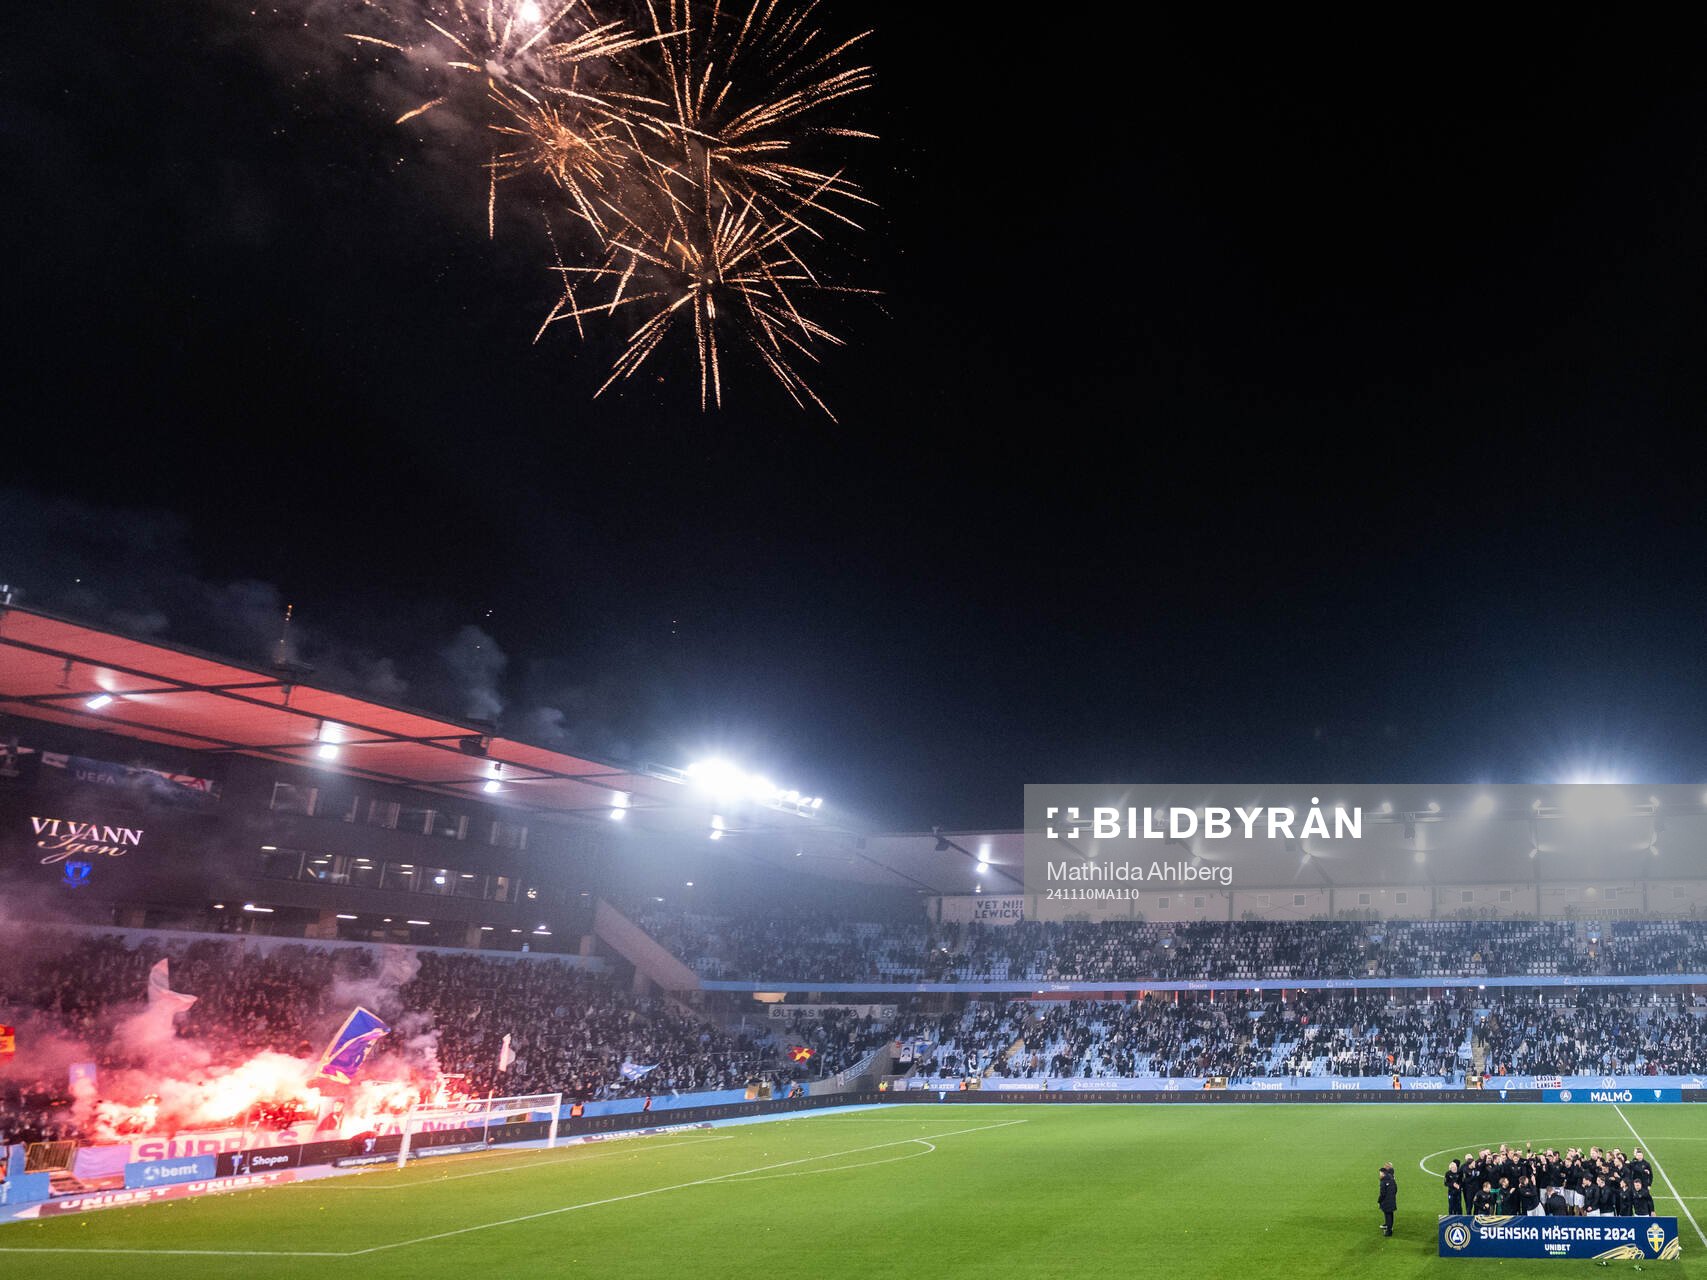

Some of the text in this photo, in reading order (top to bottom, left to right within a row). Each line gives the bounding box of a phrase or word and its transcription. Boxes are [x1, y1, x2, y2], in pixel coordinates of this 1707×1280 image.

[74, 770, 117, 785] UEFA
[30, 816, 61, 838] VI
[976, 900, 998, 909] VET
[772, 1008, 815, 1018] ØLTAS
[1332, 1080, 1360, 1090] Boozt
[1410, 1080, 1443, 1090] visolve
[1590, 1089, 1633, 1102] MALMÖ
[252, 1155, 289, 1167] Shopen
[161, 1164, 199, 1178] bemt
[187, 1173, 282, 1191] UNIBET
[59, 1188, 171, 1209] UNIBET
[1480, 1227, 1539, 1240] SVENSKA
[1542, 1225, 1601, 1241] MÄSTARE
[1604, 1227, 1635, 1241] 2024
[1544, 1243, 1571, 1252] UNIBET
